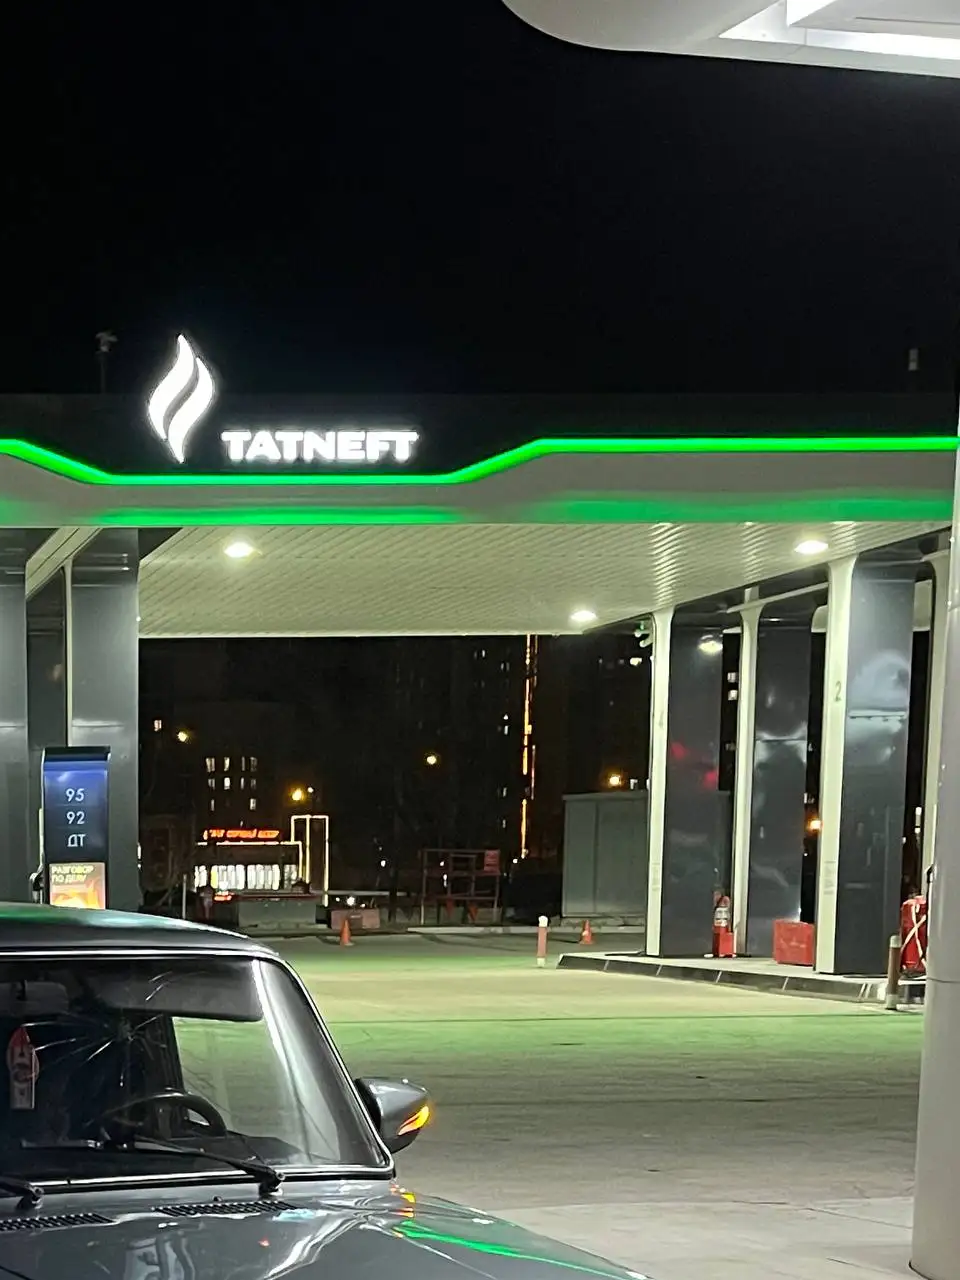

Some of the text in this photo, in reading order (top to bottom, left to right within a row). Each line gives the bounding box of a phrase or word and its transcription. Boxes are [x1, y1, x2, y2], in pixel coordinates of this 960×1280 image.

[221, 430, 419, 462] TATNEFT
[66, 788, 85, 802] 95
[66, 811, 85, 825] 92
[67, 833, 86, 848] ДТ
